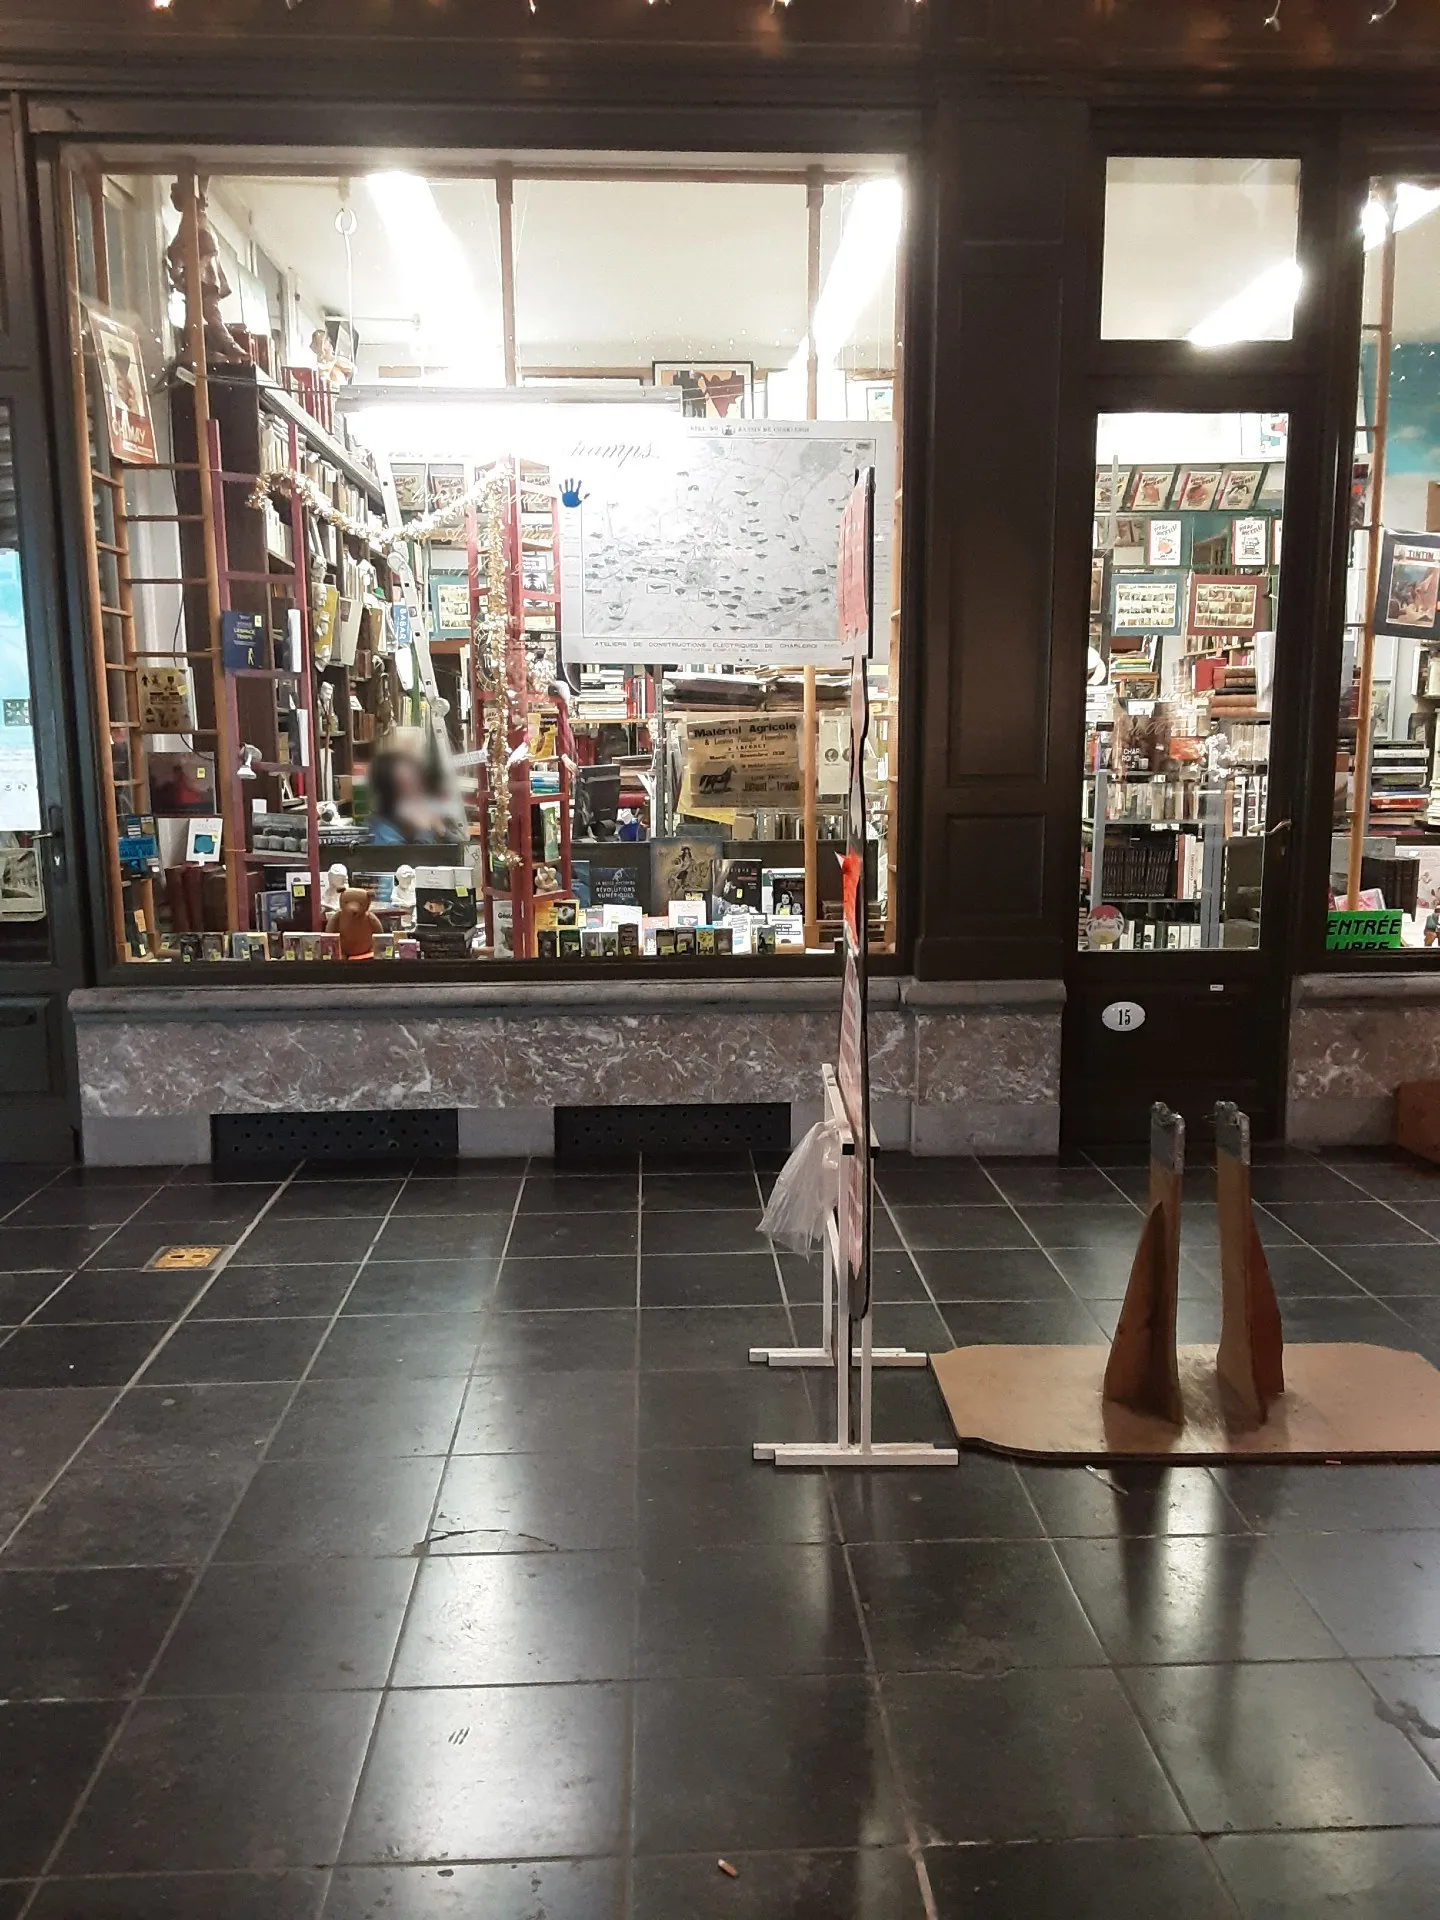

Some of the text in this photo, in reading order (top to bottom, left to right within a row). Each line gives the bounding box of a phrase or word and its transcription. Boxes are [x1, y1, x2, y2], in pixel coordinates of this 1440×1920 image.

[1407, 549, 1435, 560] TINTIN
[399, 608, 407, 640] BABAR
[694, 722, 797, 737] Matériel Agricole
[1328, 915, 1402, 935] ENTRÉE
[1119, 1009, 1131, 1026] 15
